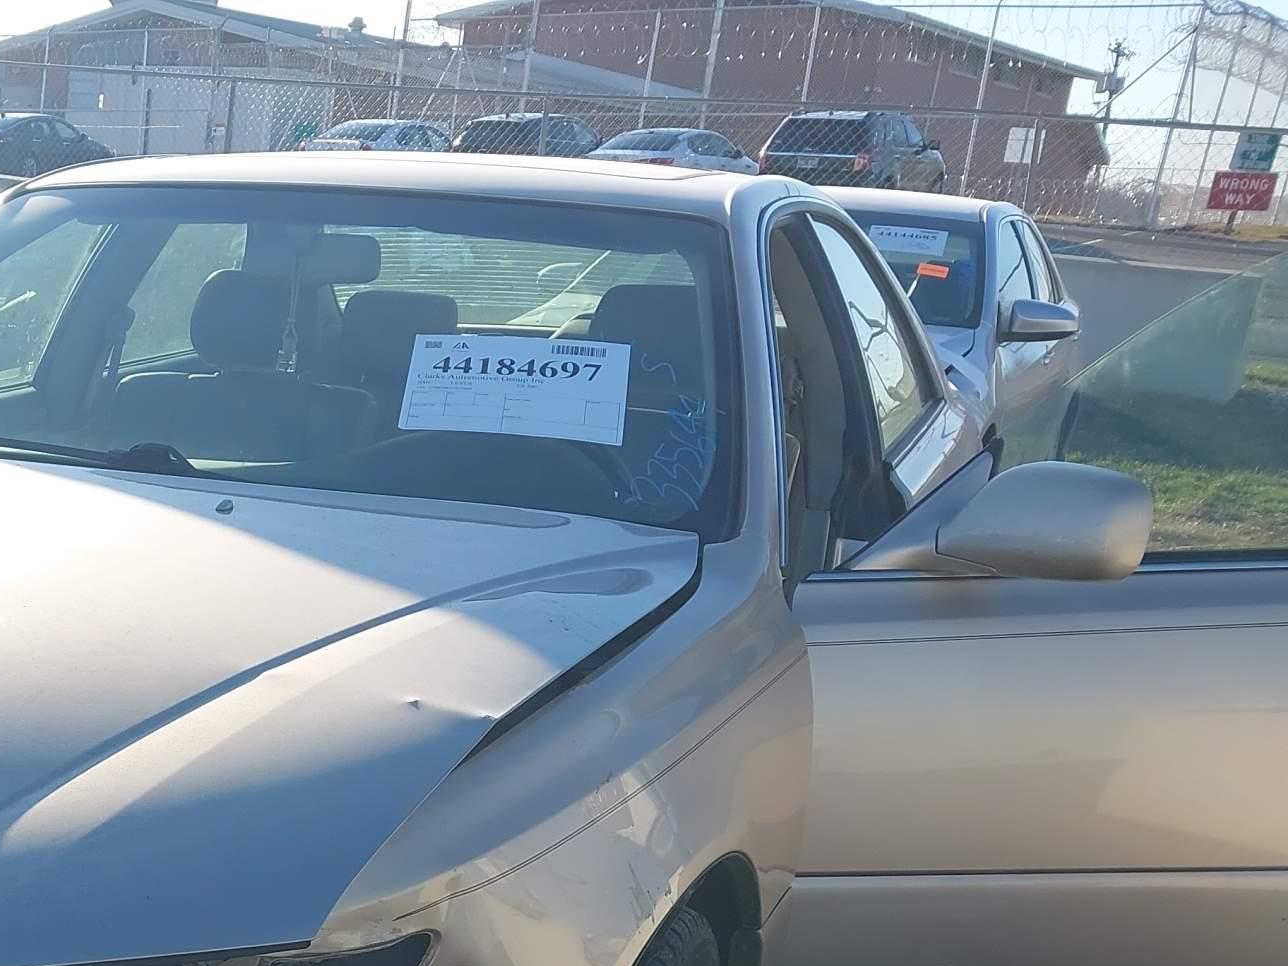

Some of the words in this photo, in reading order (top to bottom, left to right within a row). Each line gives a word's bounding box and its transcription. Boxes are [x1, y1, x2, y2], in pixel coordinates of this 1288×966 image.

[1219, 177, 1270, 191] WRONG
[1224, 192, 1256, 205] WAY
[432, 355, 602, 382] 44184697
[447, 373, 499, 383] Automotive
[501, 376, 529, 384] Group
